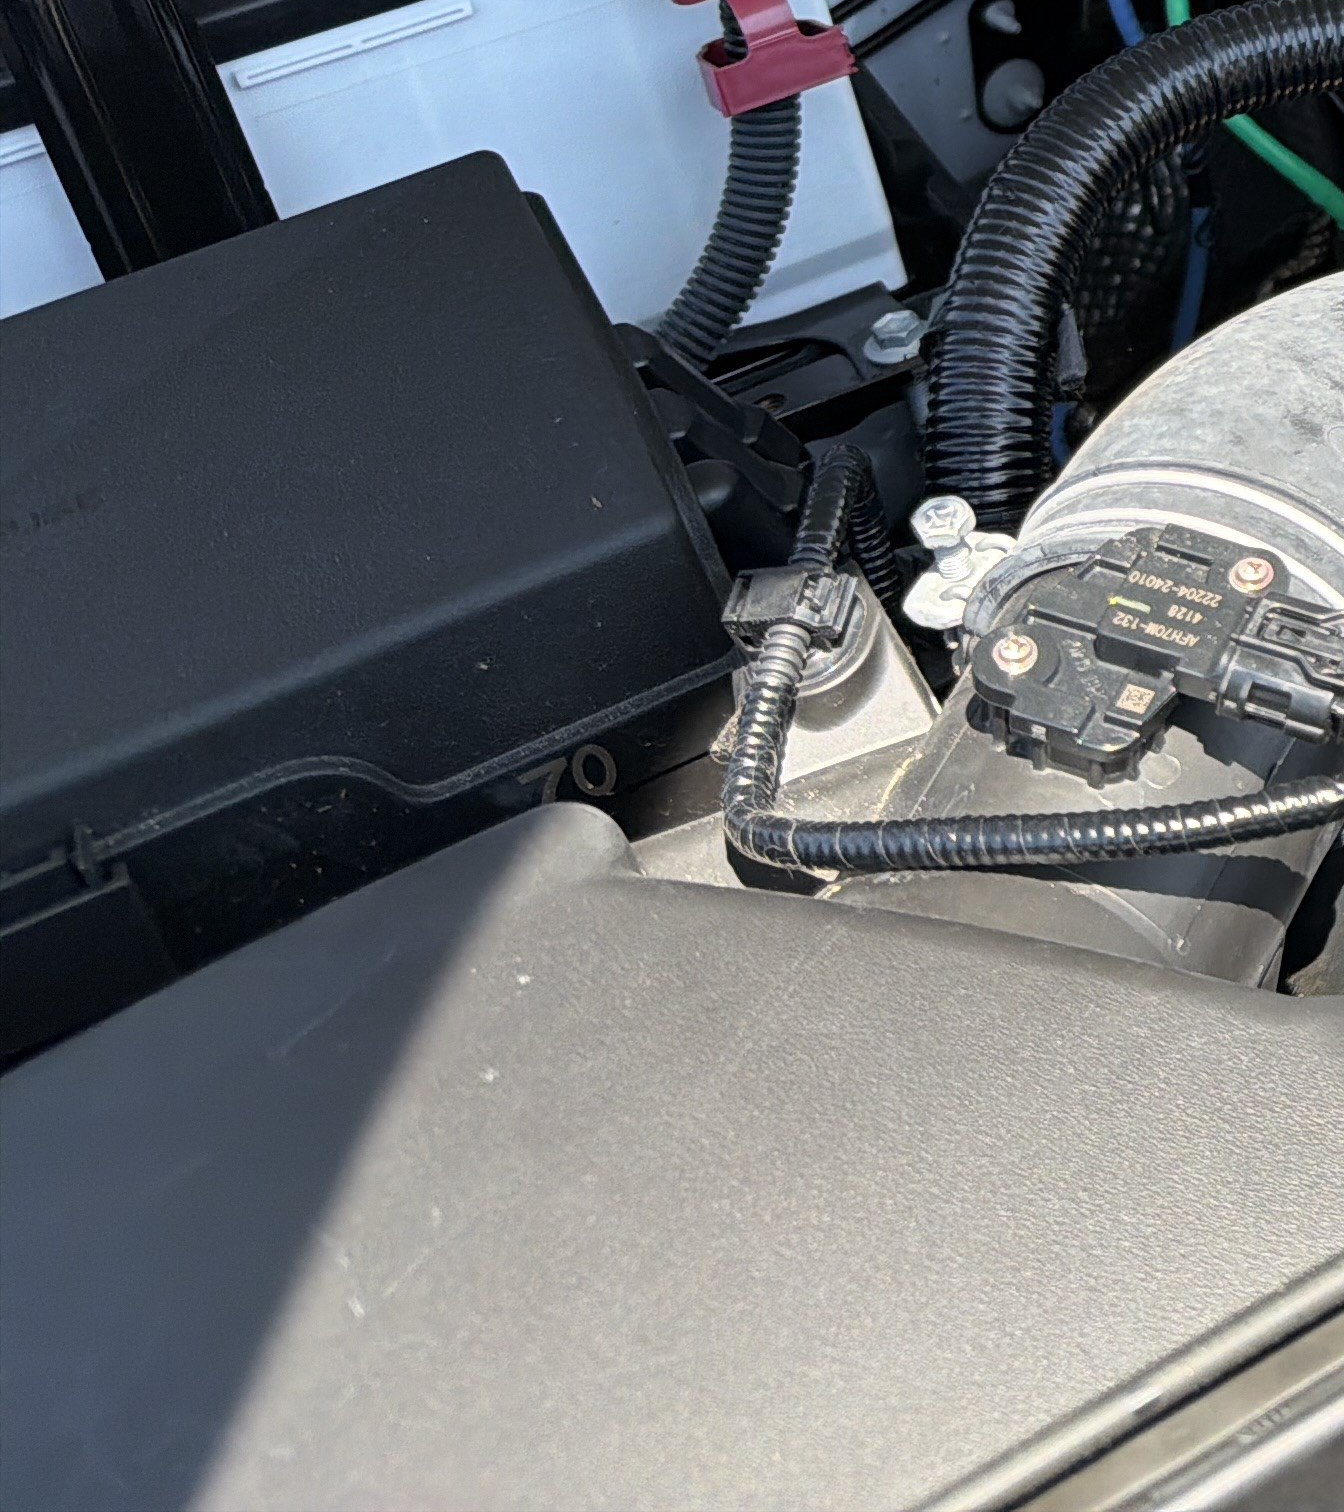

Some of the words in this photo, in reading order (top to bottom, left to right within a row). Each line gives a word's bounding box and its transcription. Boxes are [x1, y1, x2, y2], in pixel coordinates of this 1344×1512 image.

[1128, 570, 1223, 608] 22204-24010
[1112, 611, 1201, 647] AFH70M-132
[1167, 604, 1204, 624] 4128
[516, 744, 617, 804] 70
